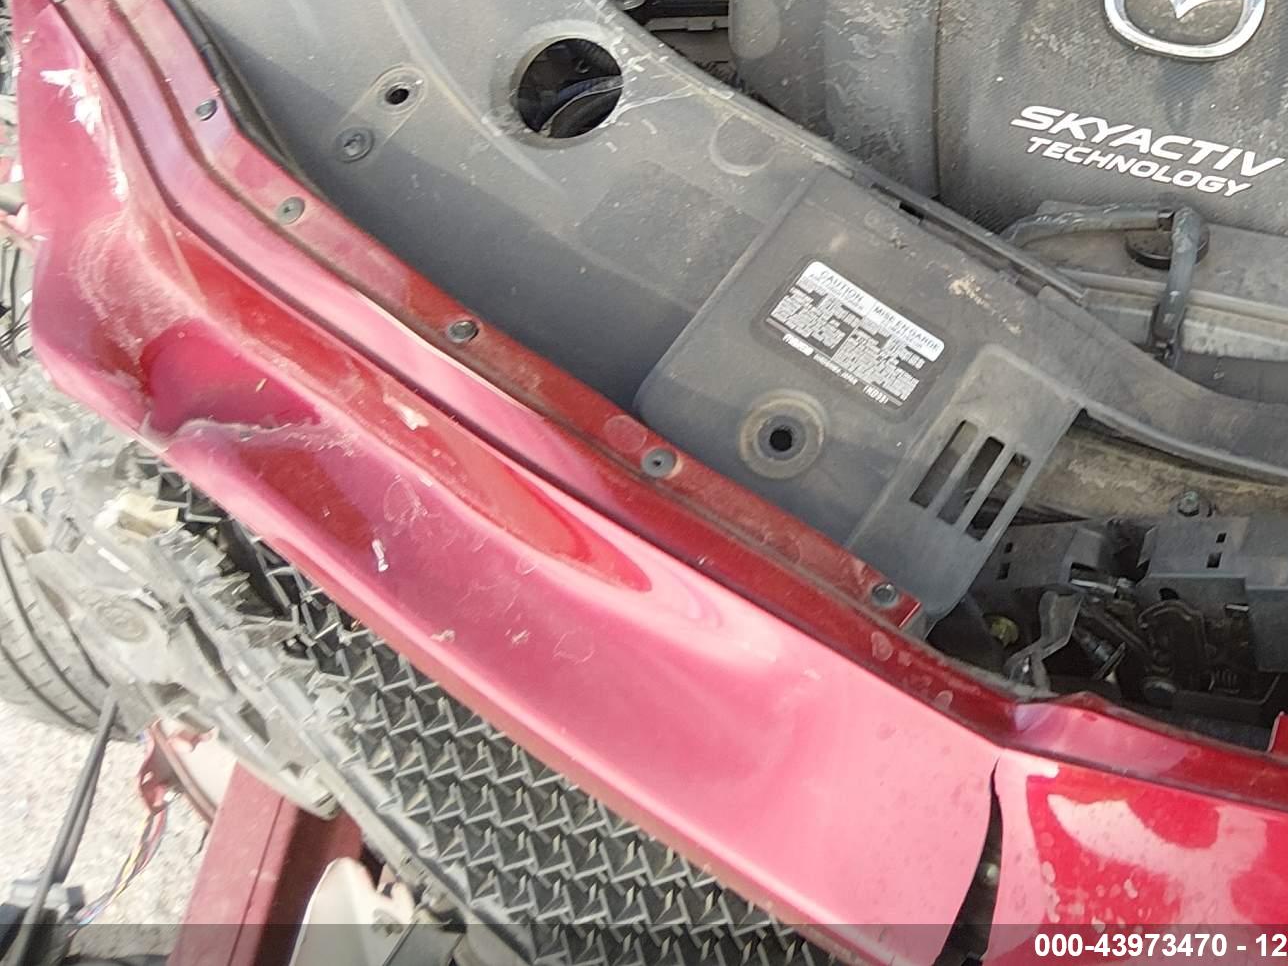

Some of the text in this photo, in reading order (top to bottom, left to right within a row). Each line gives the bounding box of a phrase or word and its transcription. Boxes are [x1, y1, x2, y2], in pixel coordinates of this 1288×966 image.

[1010, 105, 1286, 177] SKYACTIV
[1026, 136, 1252, 197] TECHNOLOGY
[820, 270, 865, 303] CAUTION
